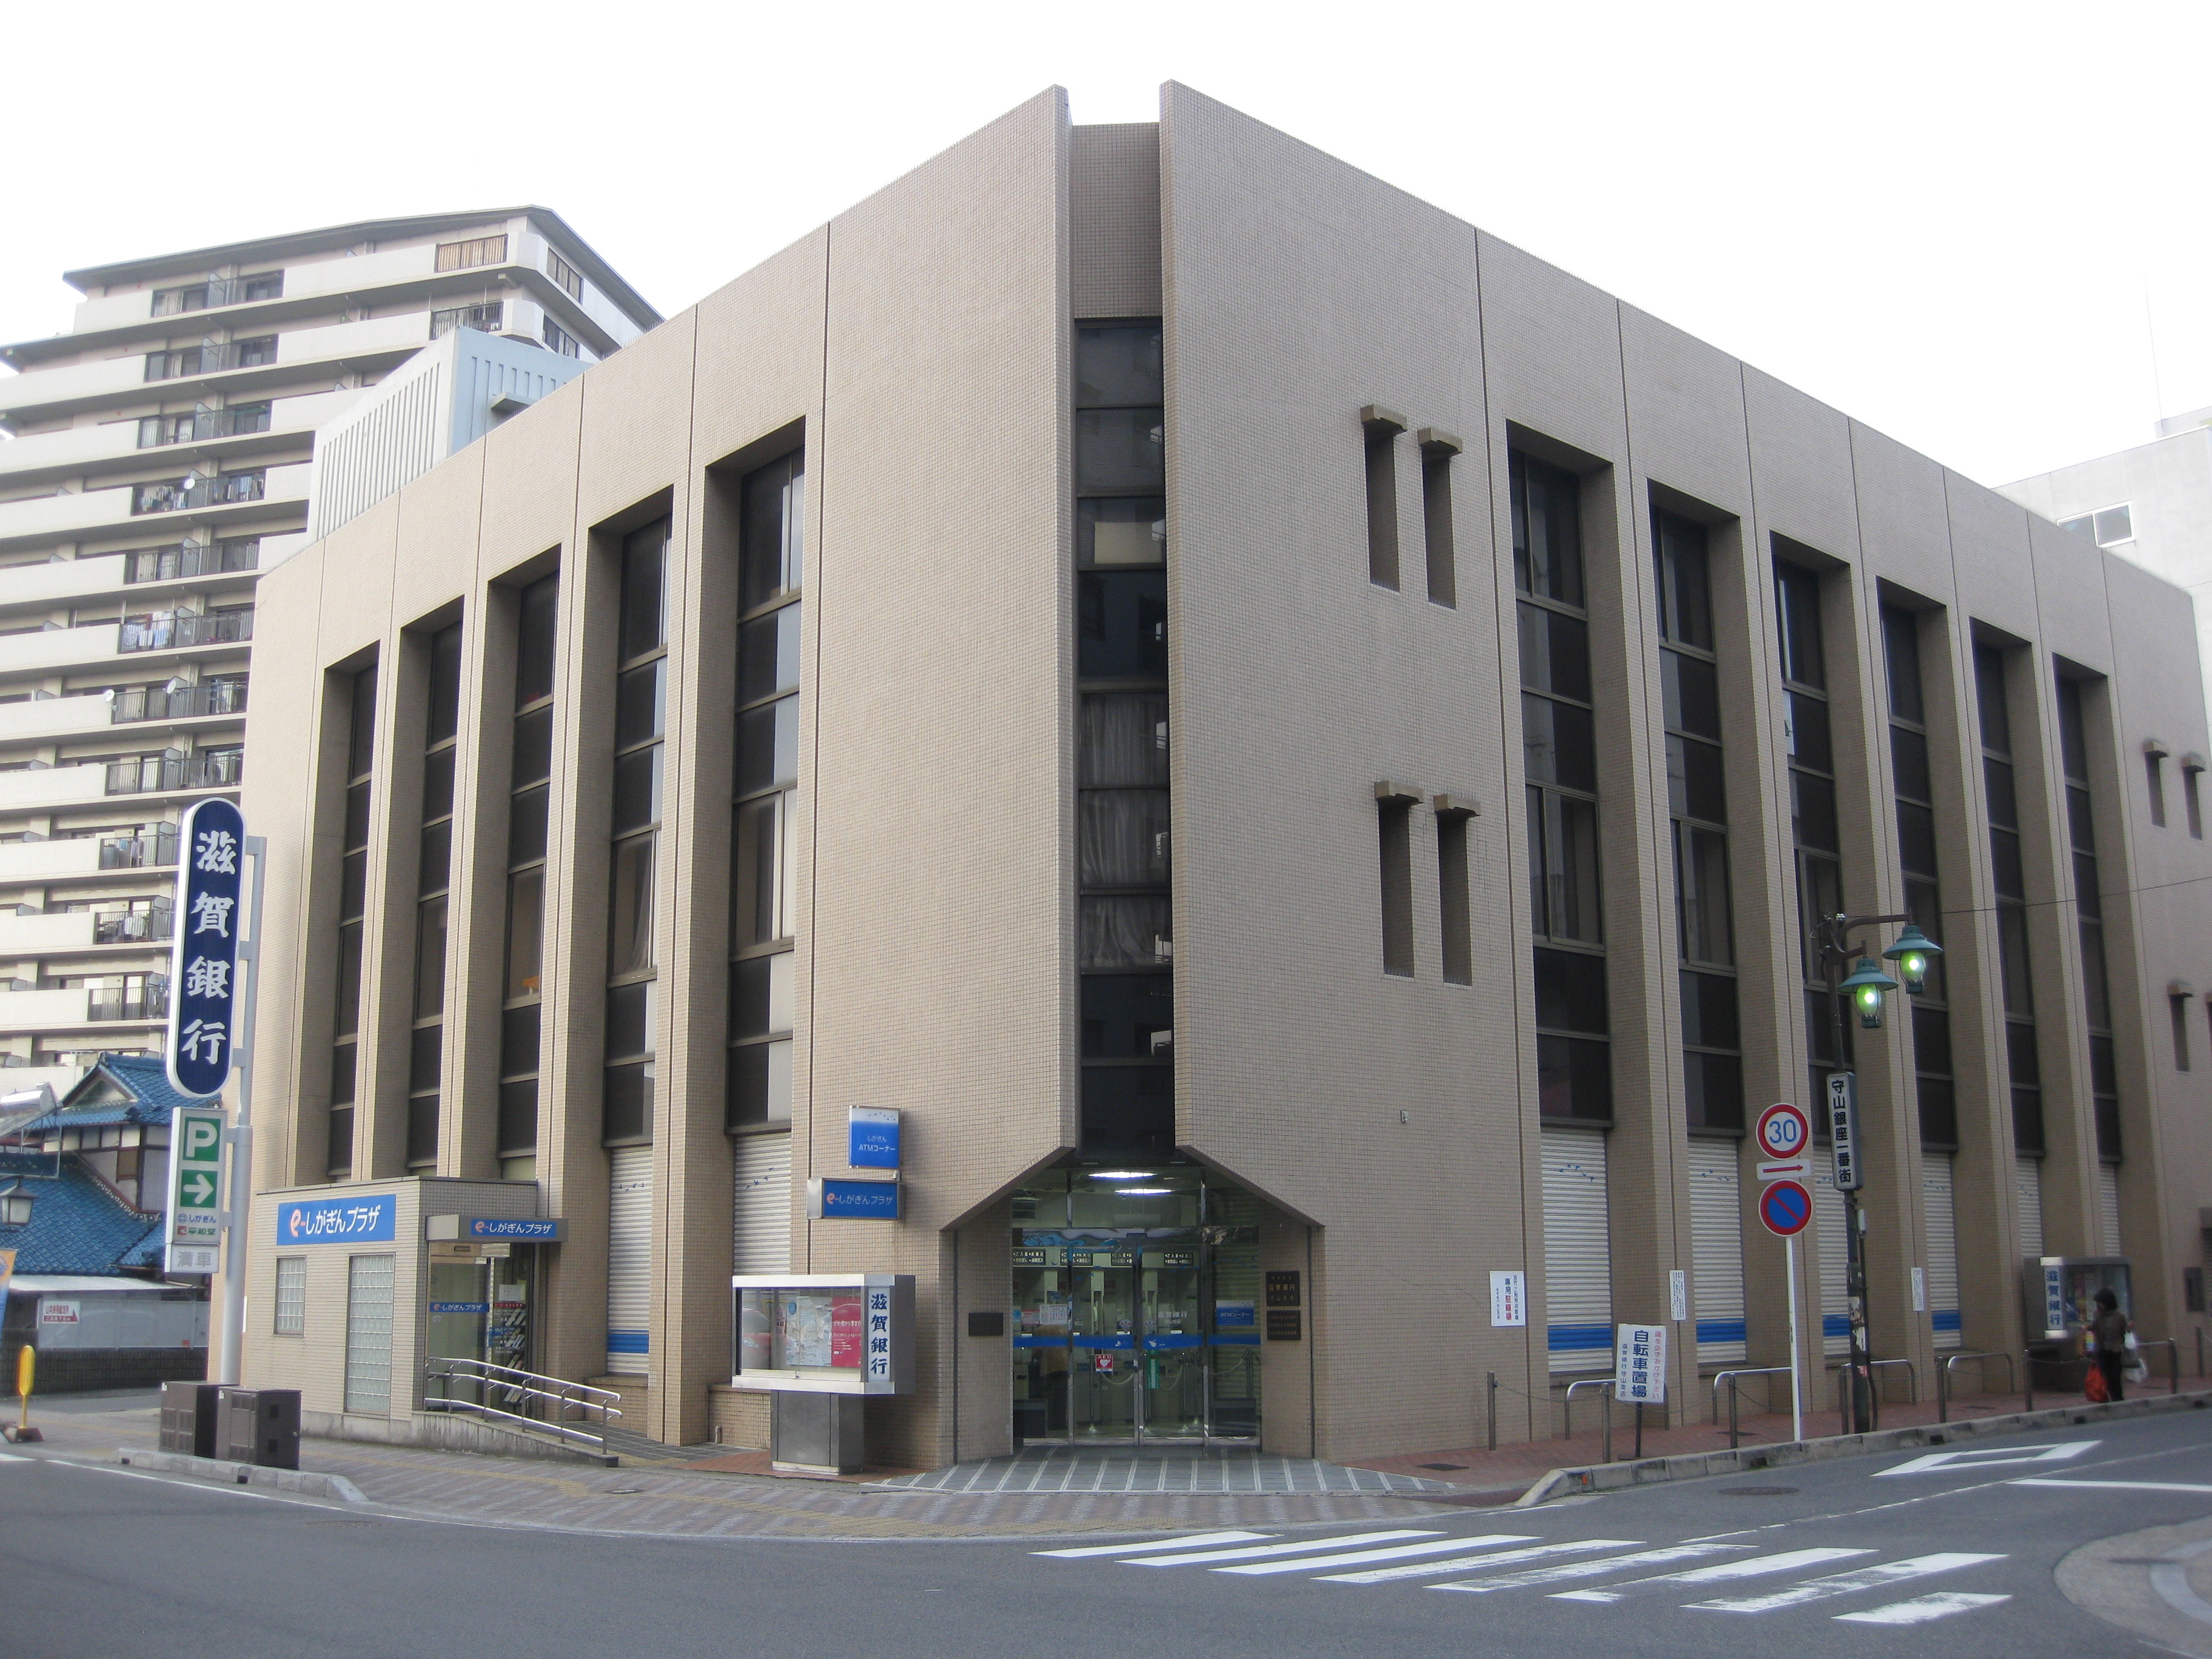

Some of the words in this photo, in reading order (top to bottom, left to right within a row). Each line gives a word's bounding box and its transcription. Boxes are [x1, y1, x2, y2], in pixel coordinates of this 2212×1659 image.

[181, 830, 237, 1065] 滋賀銀行
[186, 1121, 217, 1157] P
[859, 1144, 896, 1152] ATMコーナー
[1769, 1119, 1797, 1144] 30
[1831, 1079, 1851, 1183] 守山銀座一番街
[189, 1214, 216, 1223] しがぎん
[178, 1251, 211, 1268] 満車
[2046, 1270, 2062, 1326] 滋賀銀行
[870, 1293, 888, 1375] 滋賀銀行
[1631, 1330, 1649, 1398] 自転車置場
